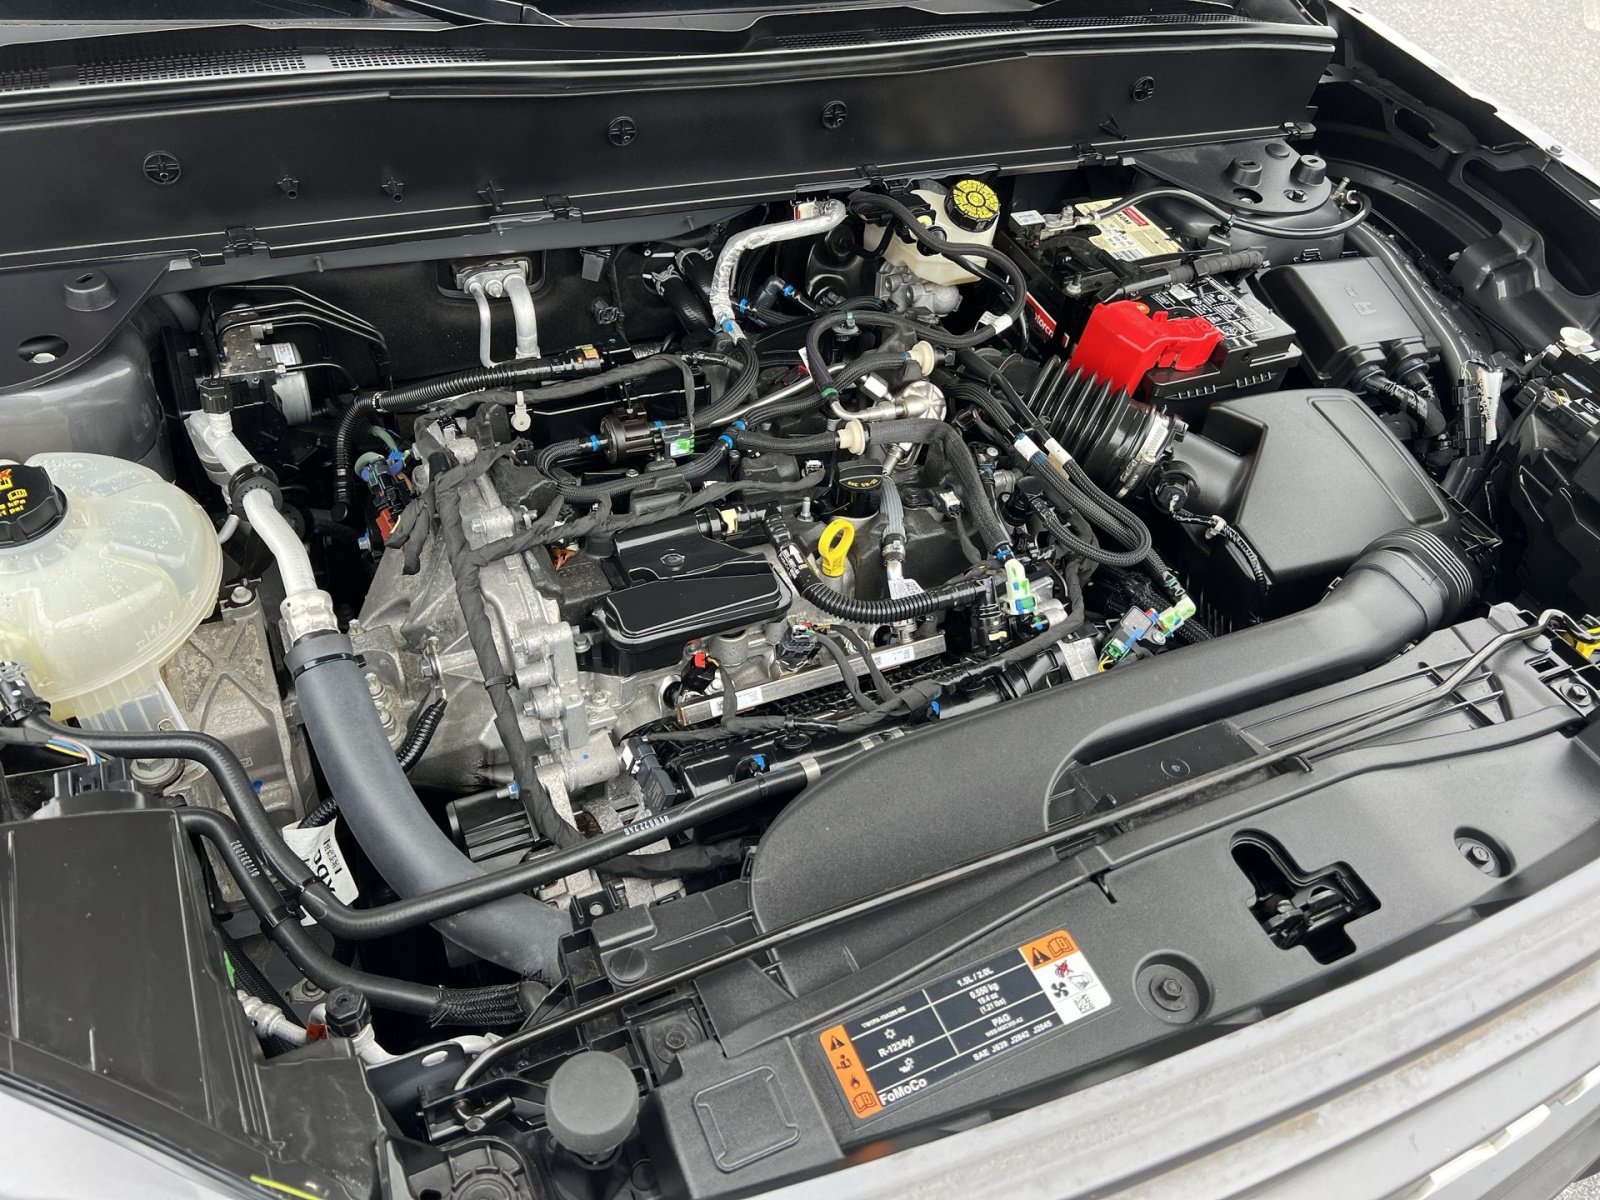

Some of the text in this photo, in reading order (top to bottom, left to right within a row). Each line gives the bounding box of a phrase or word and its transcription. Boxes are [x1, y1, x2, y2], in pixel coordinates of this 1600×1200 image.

[956, 973, 974, 987] 1.5L
[976, 966, 995, 979] 2.0L
[969, 981, 1000, 999] 0.550 kg
[991, 1013, 1011, 1027] PAG
[877, 1035, 916, 1058] R-1234yf
[972, 1020, 1053, 1062] SAE J639 J2842 J2845
[878, 1077, 928, 1106] FoMoCo
